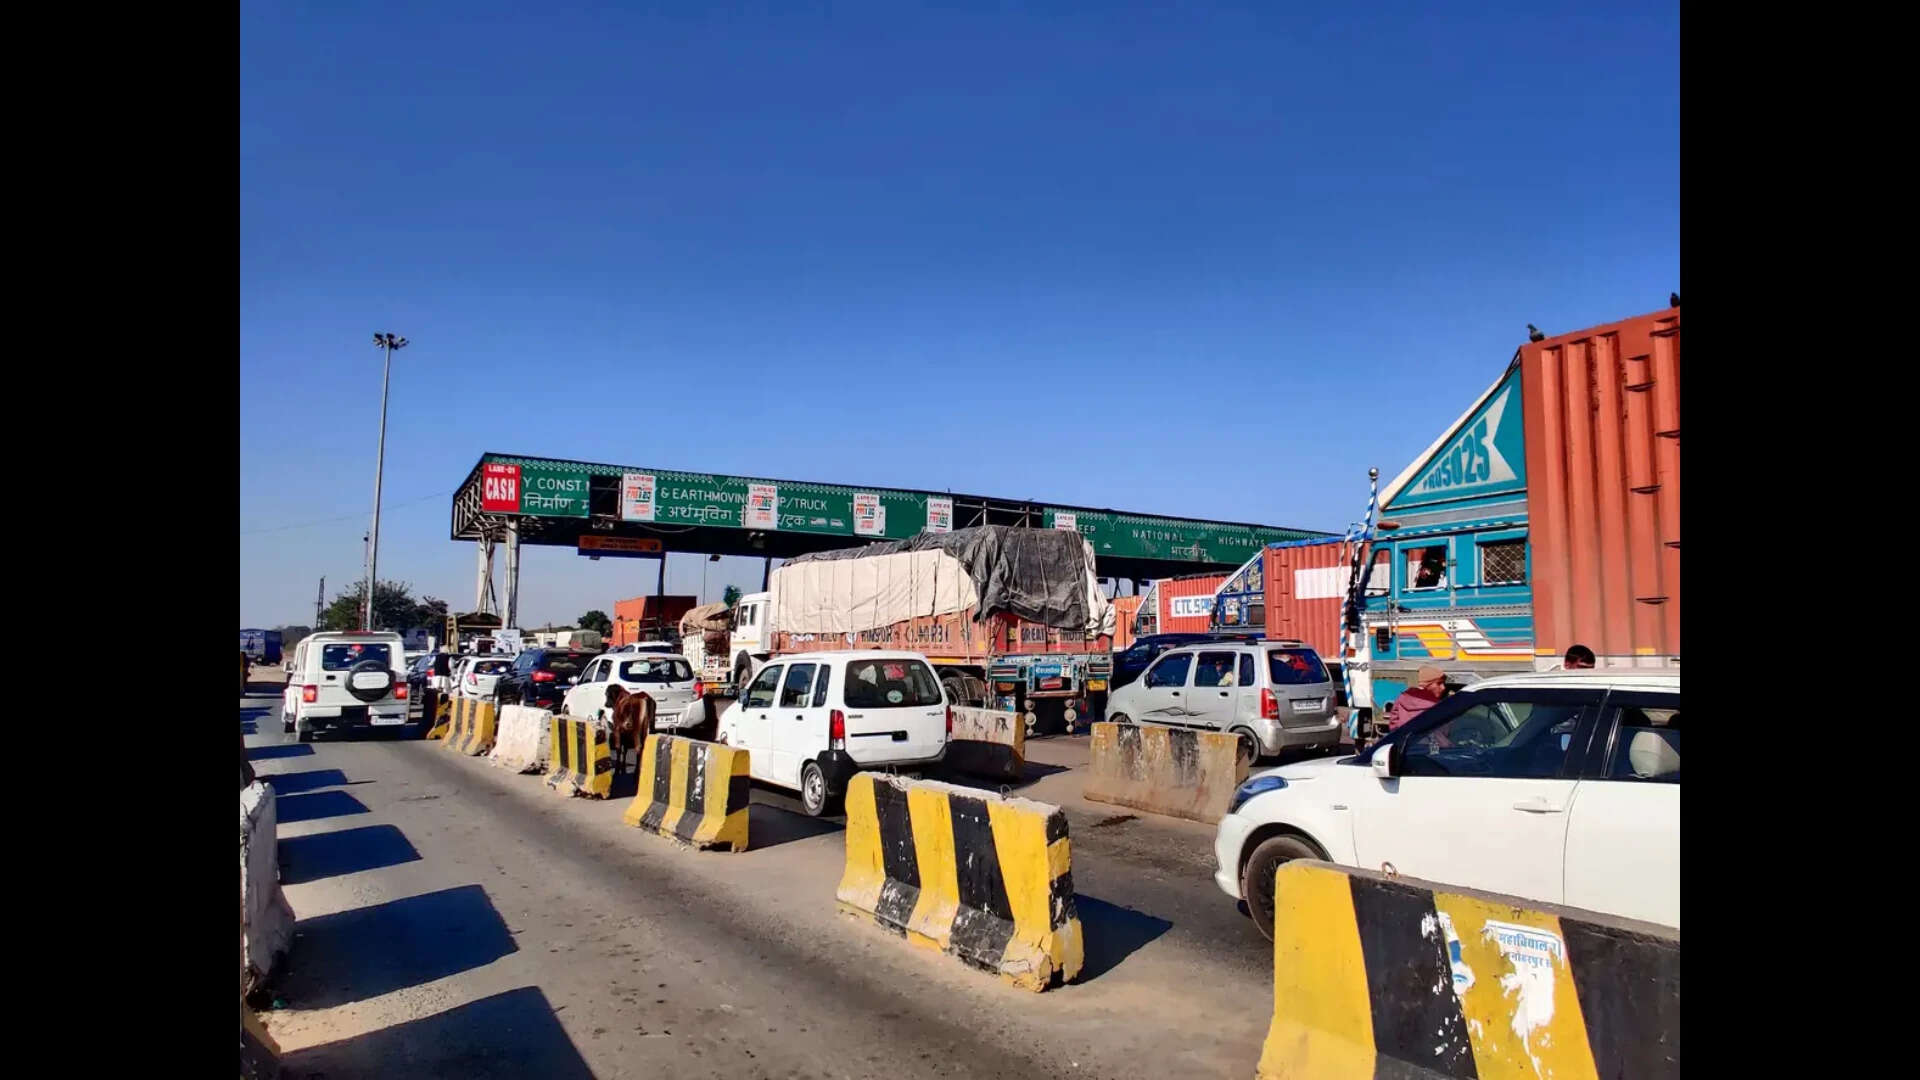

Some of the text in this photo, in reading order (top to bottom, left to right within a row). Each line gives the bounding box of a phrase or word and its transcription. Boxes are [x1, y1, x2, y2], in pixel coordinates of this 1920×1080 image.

[485, 477, 516, 501] CASH
[660, 487, 669, 499] &
[524, 491, 574, 510] निर्माण
[1078, 524, 1097, 534] EEP
[1132, 529, 1185, 543] NATIONAL
[1218, 536, 1266, 548] HIGHWAYS
[1171, 544, 1208, 558] भारतीय
